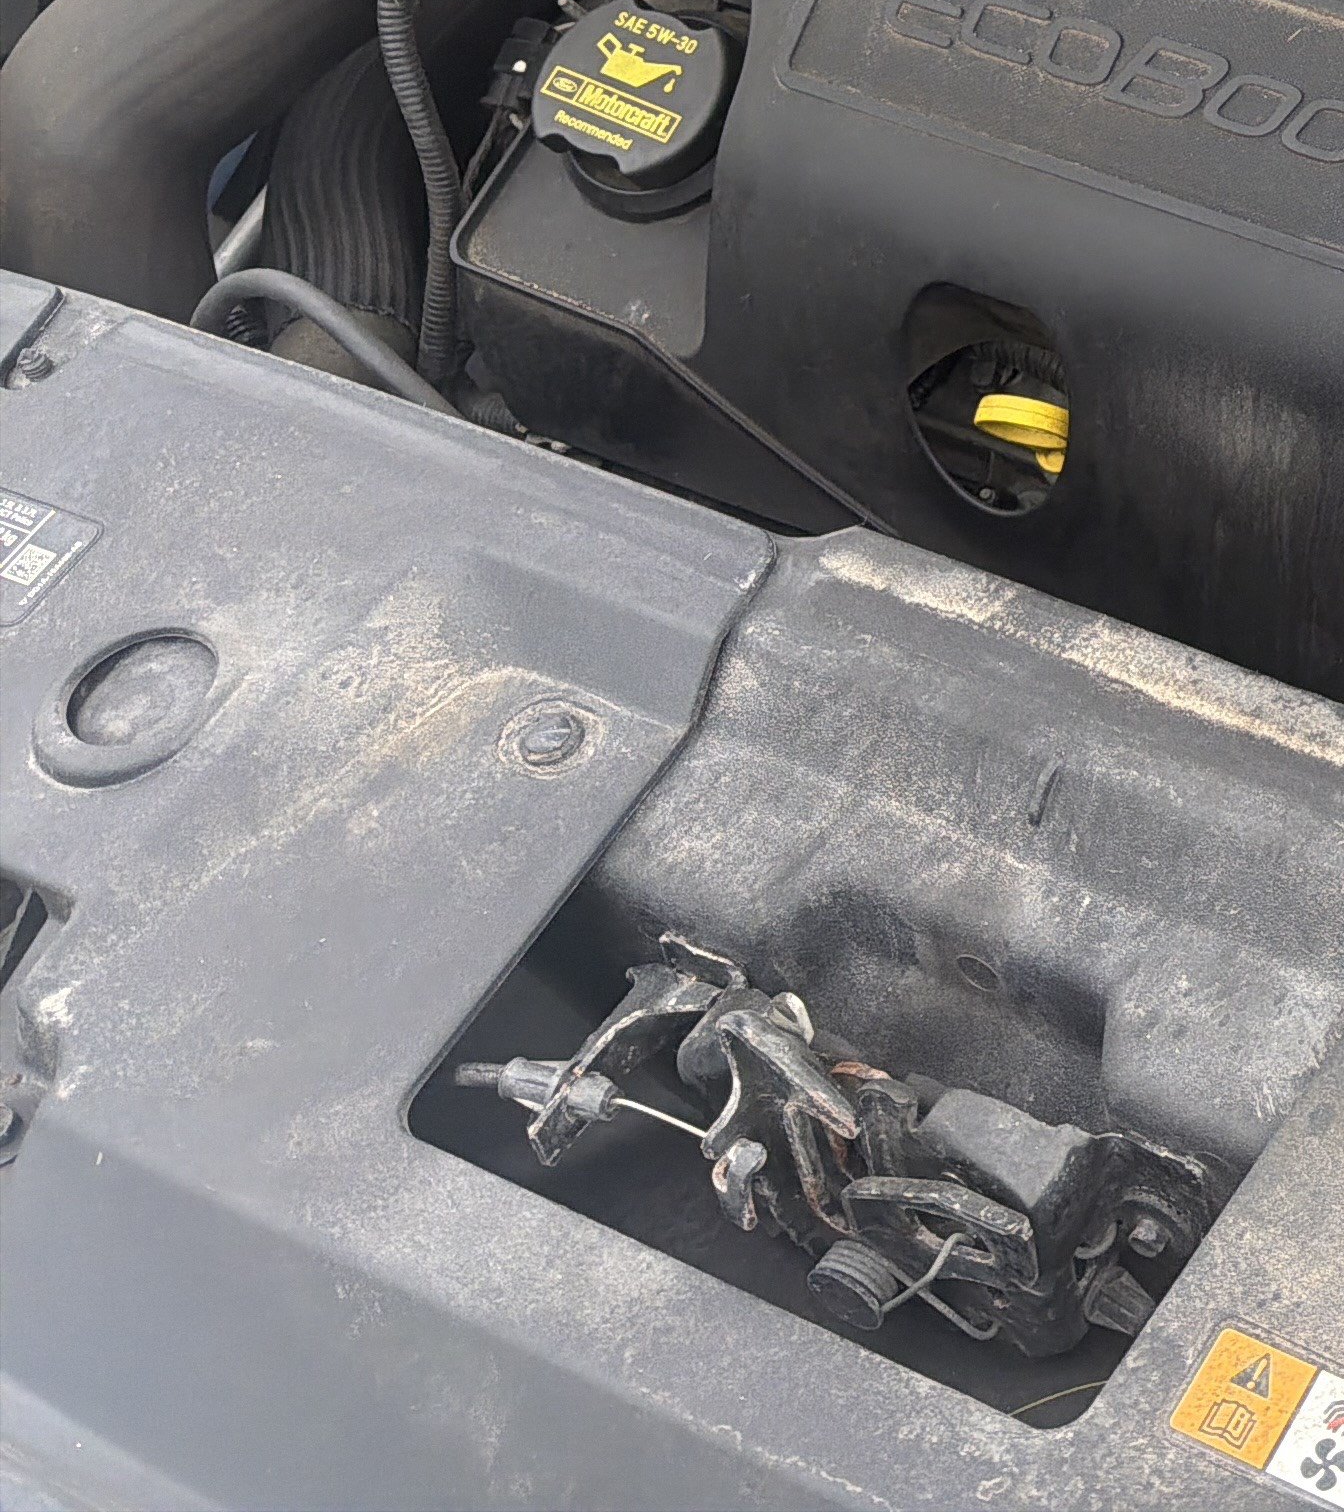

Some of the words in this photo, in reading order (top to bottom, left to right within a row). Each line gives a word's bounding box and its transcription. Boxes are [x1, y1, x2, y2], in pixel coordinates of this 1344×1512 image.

[614, 11, 648, 34] SAE
[646, 23, 698, 54] 5W-30
[554, 109, 633, 150] Recommended
[578, 84, 672, 136] Motorcraft
